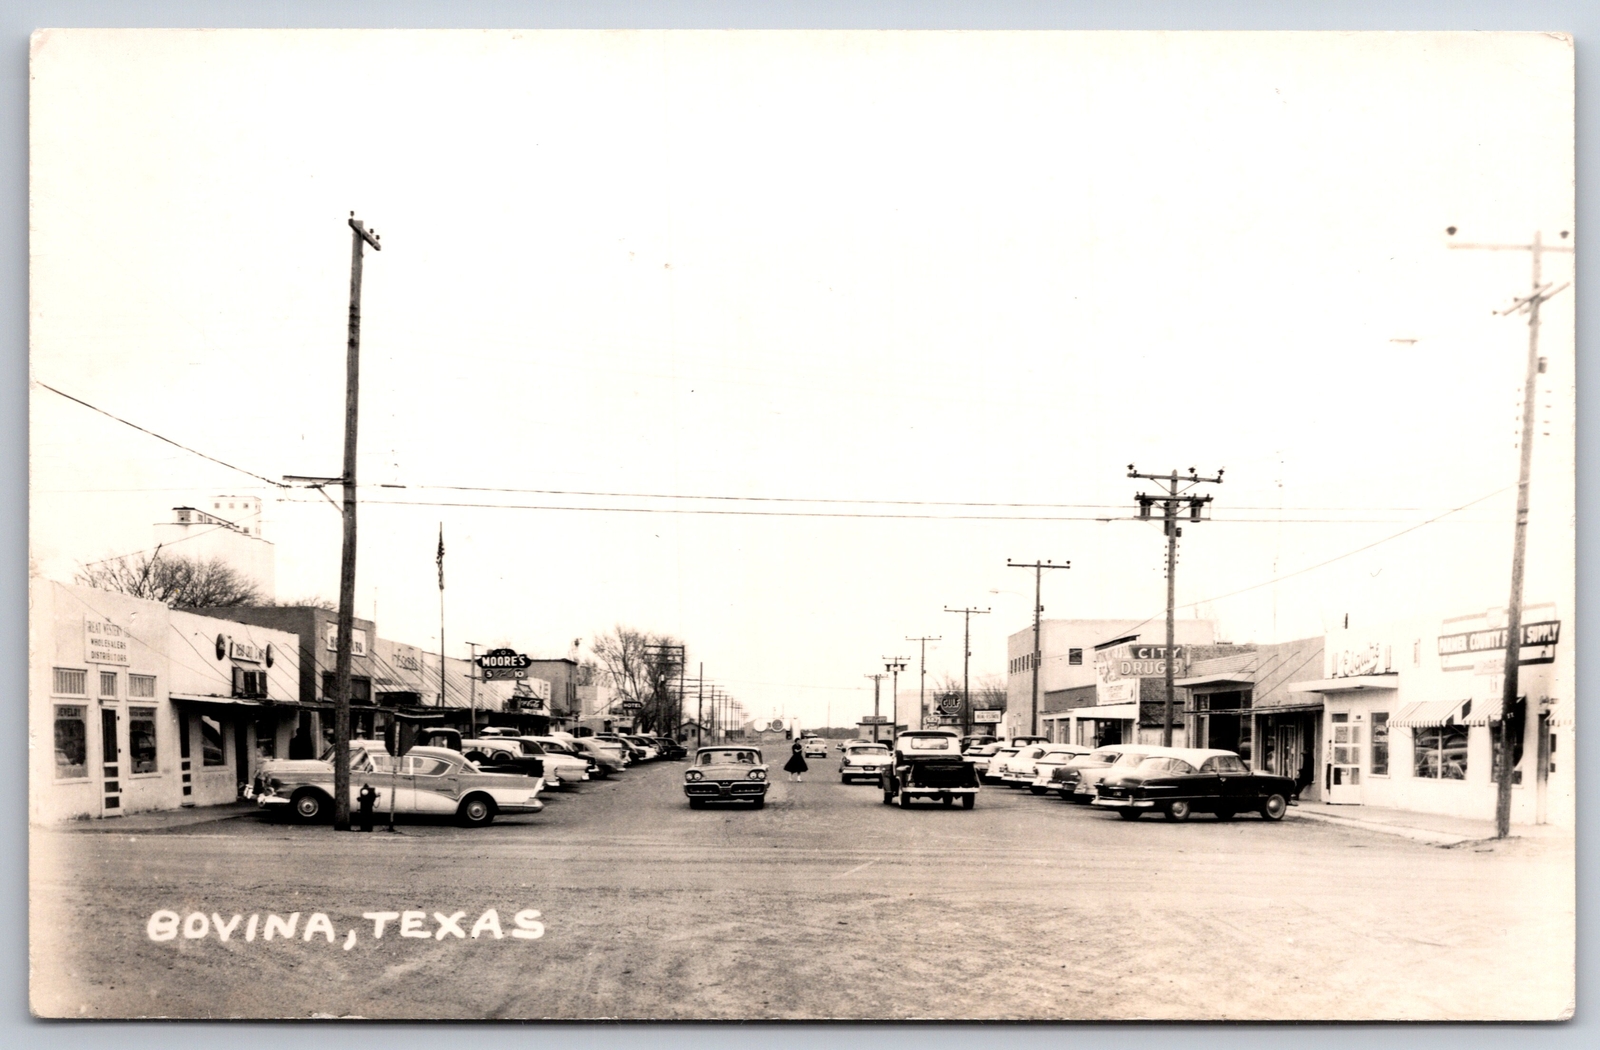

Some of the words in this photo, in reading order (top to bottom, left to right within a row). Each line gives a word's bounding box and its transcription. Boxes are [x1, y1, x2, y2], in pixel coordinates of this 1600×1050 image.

[1469, 629, 1501, 650] COUNTY
[1526, 623, 1559, 644] SUPPLY
[91, 638, 127, 650] WHOLESALERS
[91, 650, 127, 662] DISTRIBUTORS
[1138, 647, 1181, 659] CITY
[481, 655, 526, 667] MOORE'S
[485, 670, 493, 678] 5
[514, 670, 525, 678] 10
[1120, 660, 1180, 676] DRUGS
[942, 698, 960, 709] GULF
